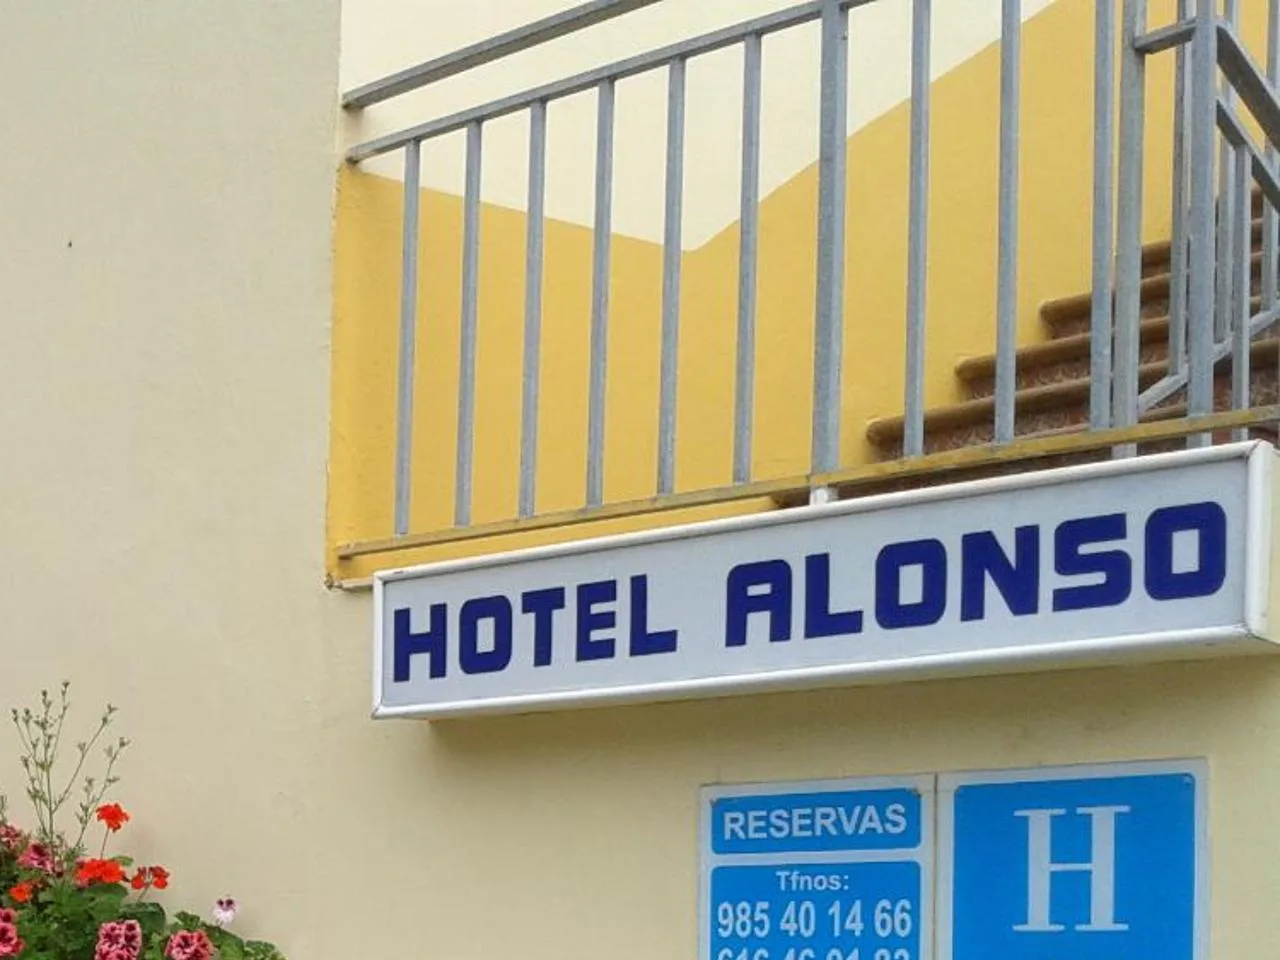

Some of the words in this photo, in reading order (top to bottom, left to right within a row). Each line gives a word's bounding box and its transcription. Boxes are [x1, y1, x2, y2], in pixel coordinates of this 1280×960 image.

[393, 573, 678, 683] HOTEL
[725, 500, 1228, 647] ALONSO
[723, 803, 908, 841] RESERVAS
[775, 870, 850, 892] Tfnos:
[1012, 804, 1131, 932] H
[717, 900, 771, 939] 985
[779, 900, 816, 938] 40
[827, 899, 864, 938] 14
[873, 898, 913, 938] 66
